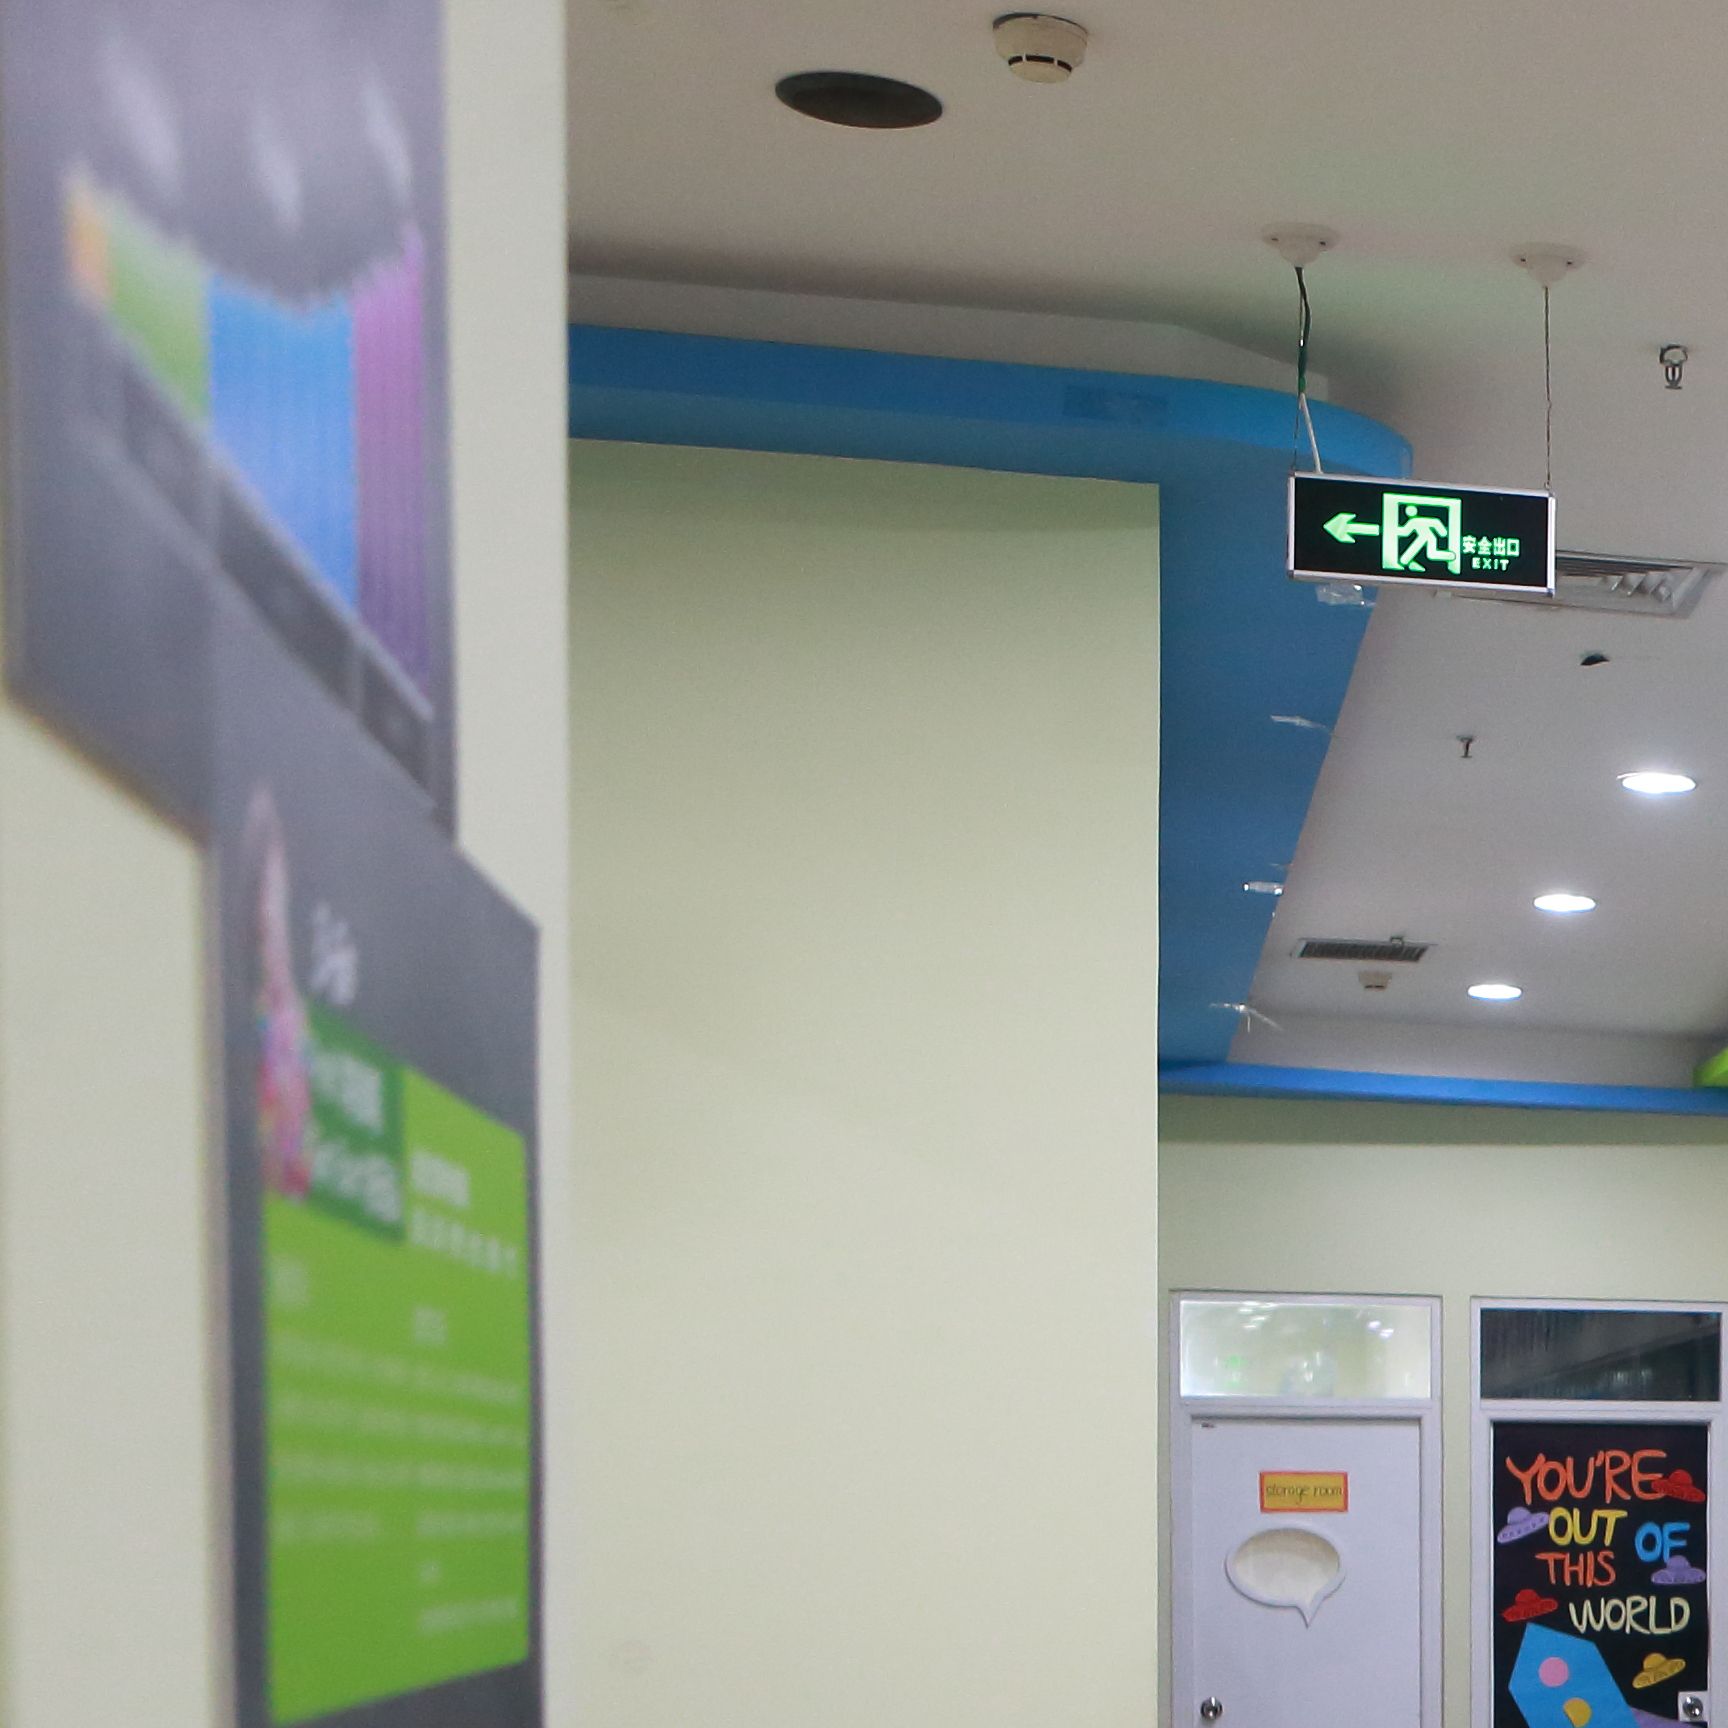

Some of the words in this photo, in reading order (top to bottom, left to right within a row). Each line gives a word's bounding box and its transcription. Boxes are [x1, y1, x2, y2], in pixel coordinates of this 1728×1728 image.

[1462, 536, 1520, 557] 安全出口
[1472, 557, 1510, 571] EXIT
[1505, 1449, 1667, 1505] YOU'RE
[1549, 1507, 1628, 1546] OUT
[1635, 1522, 1690, 1562] OF
[1535, 1551, 1616, 1588] THIS
[1569, 1595, 1690, 1634] WORLD
